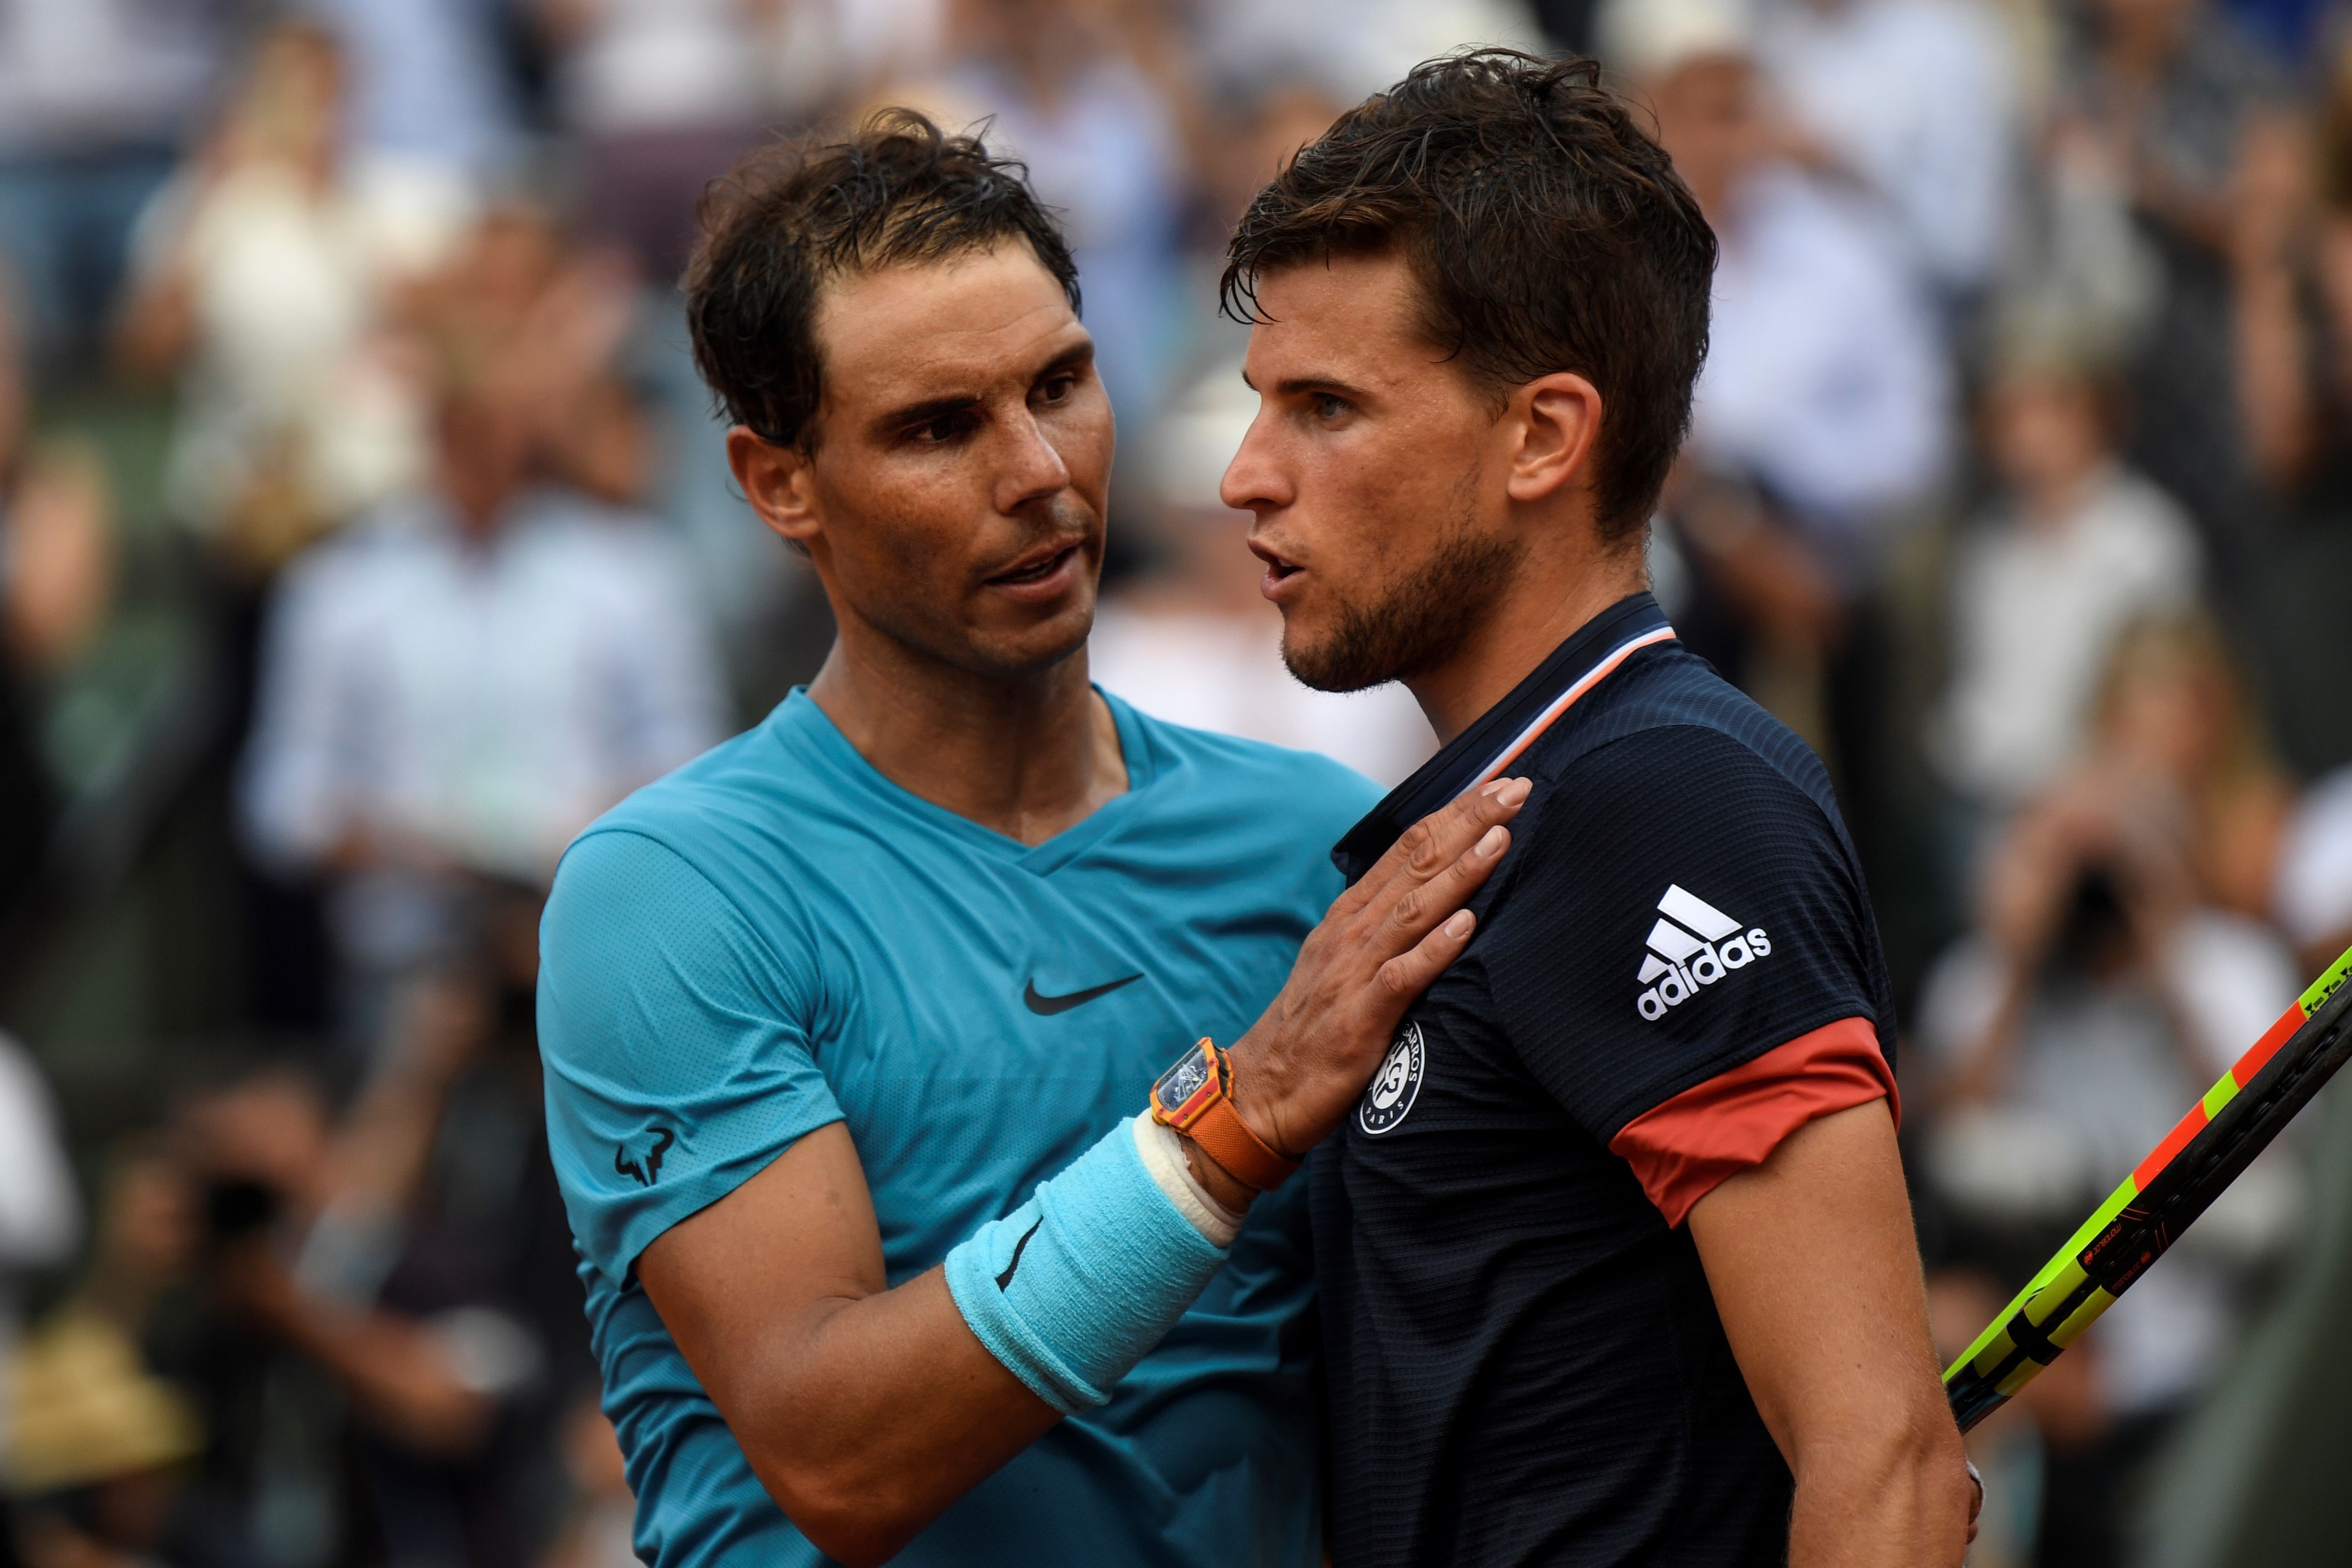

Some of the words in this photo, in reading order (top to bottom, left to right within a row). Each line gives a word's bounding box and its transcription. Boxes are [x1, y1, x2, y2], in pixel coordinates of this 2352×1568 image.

[1637, 928, 1772, 1021] adidas
[1402, 1023, 1420, 1082] GARROS
[1366, 1101, 1404, 1124] PARIS
